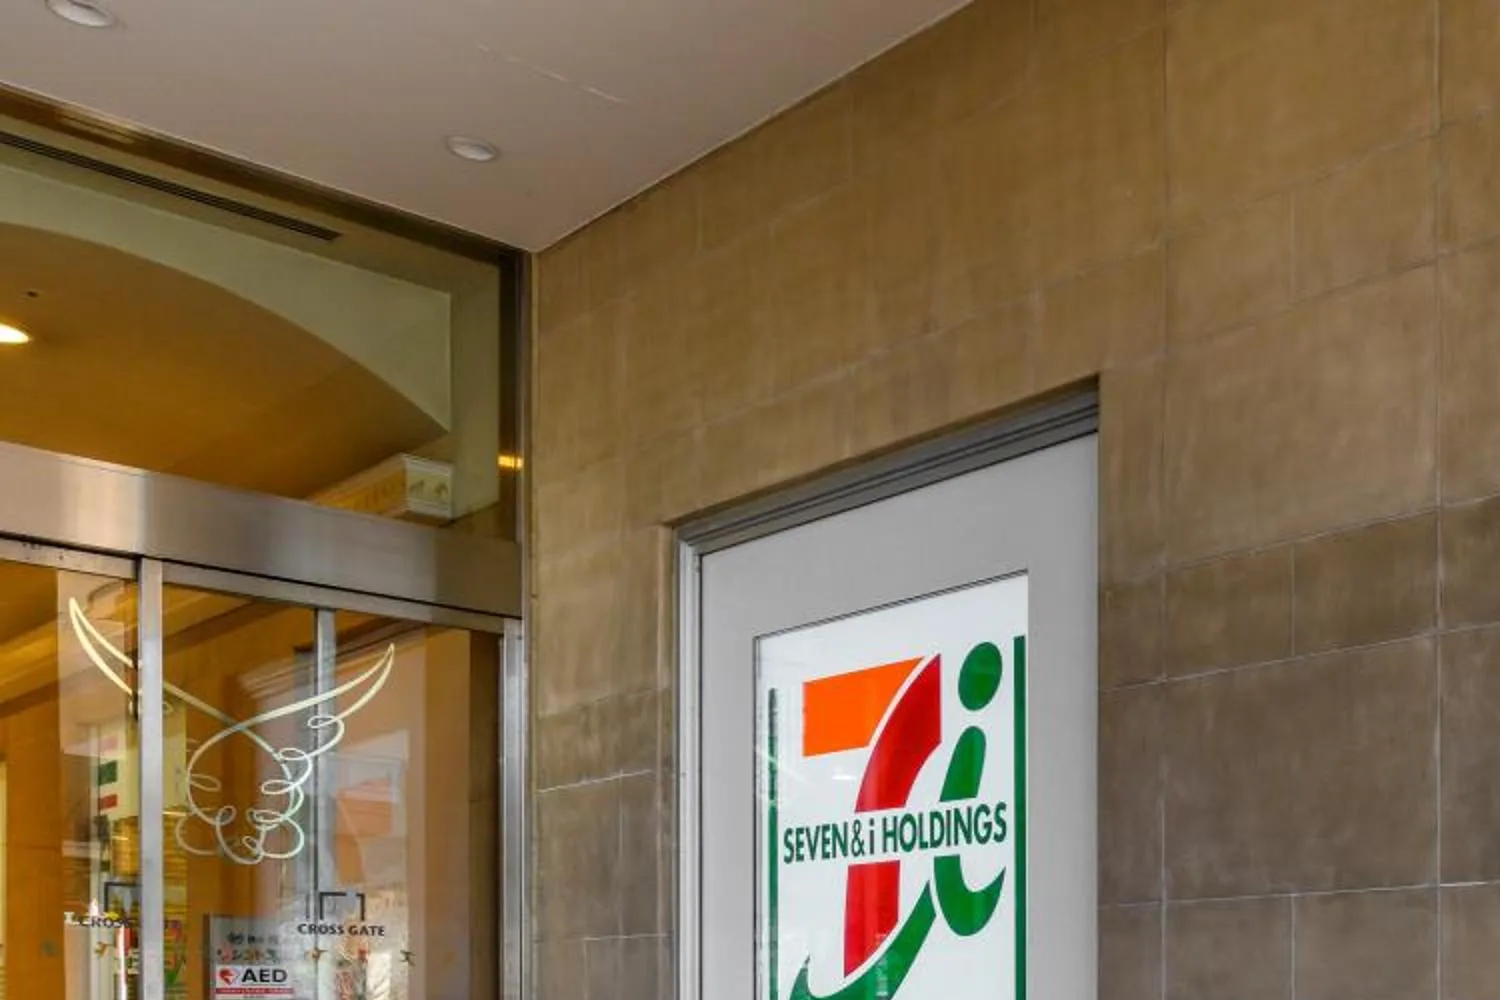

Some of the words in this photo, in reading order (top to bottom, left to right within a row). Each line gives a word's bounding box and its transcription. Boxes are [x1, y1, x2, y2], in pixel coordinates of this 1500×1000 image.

[882, 802, 1007, 854] HOLDINGS
[298, 923, 344, 935] CROSS
[348, 924, 385, 937] GATE
[241, 967, 288, 983] AED
